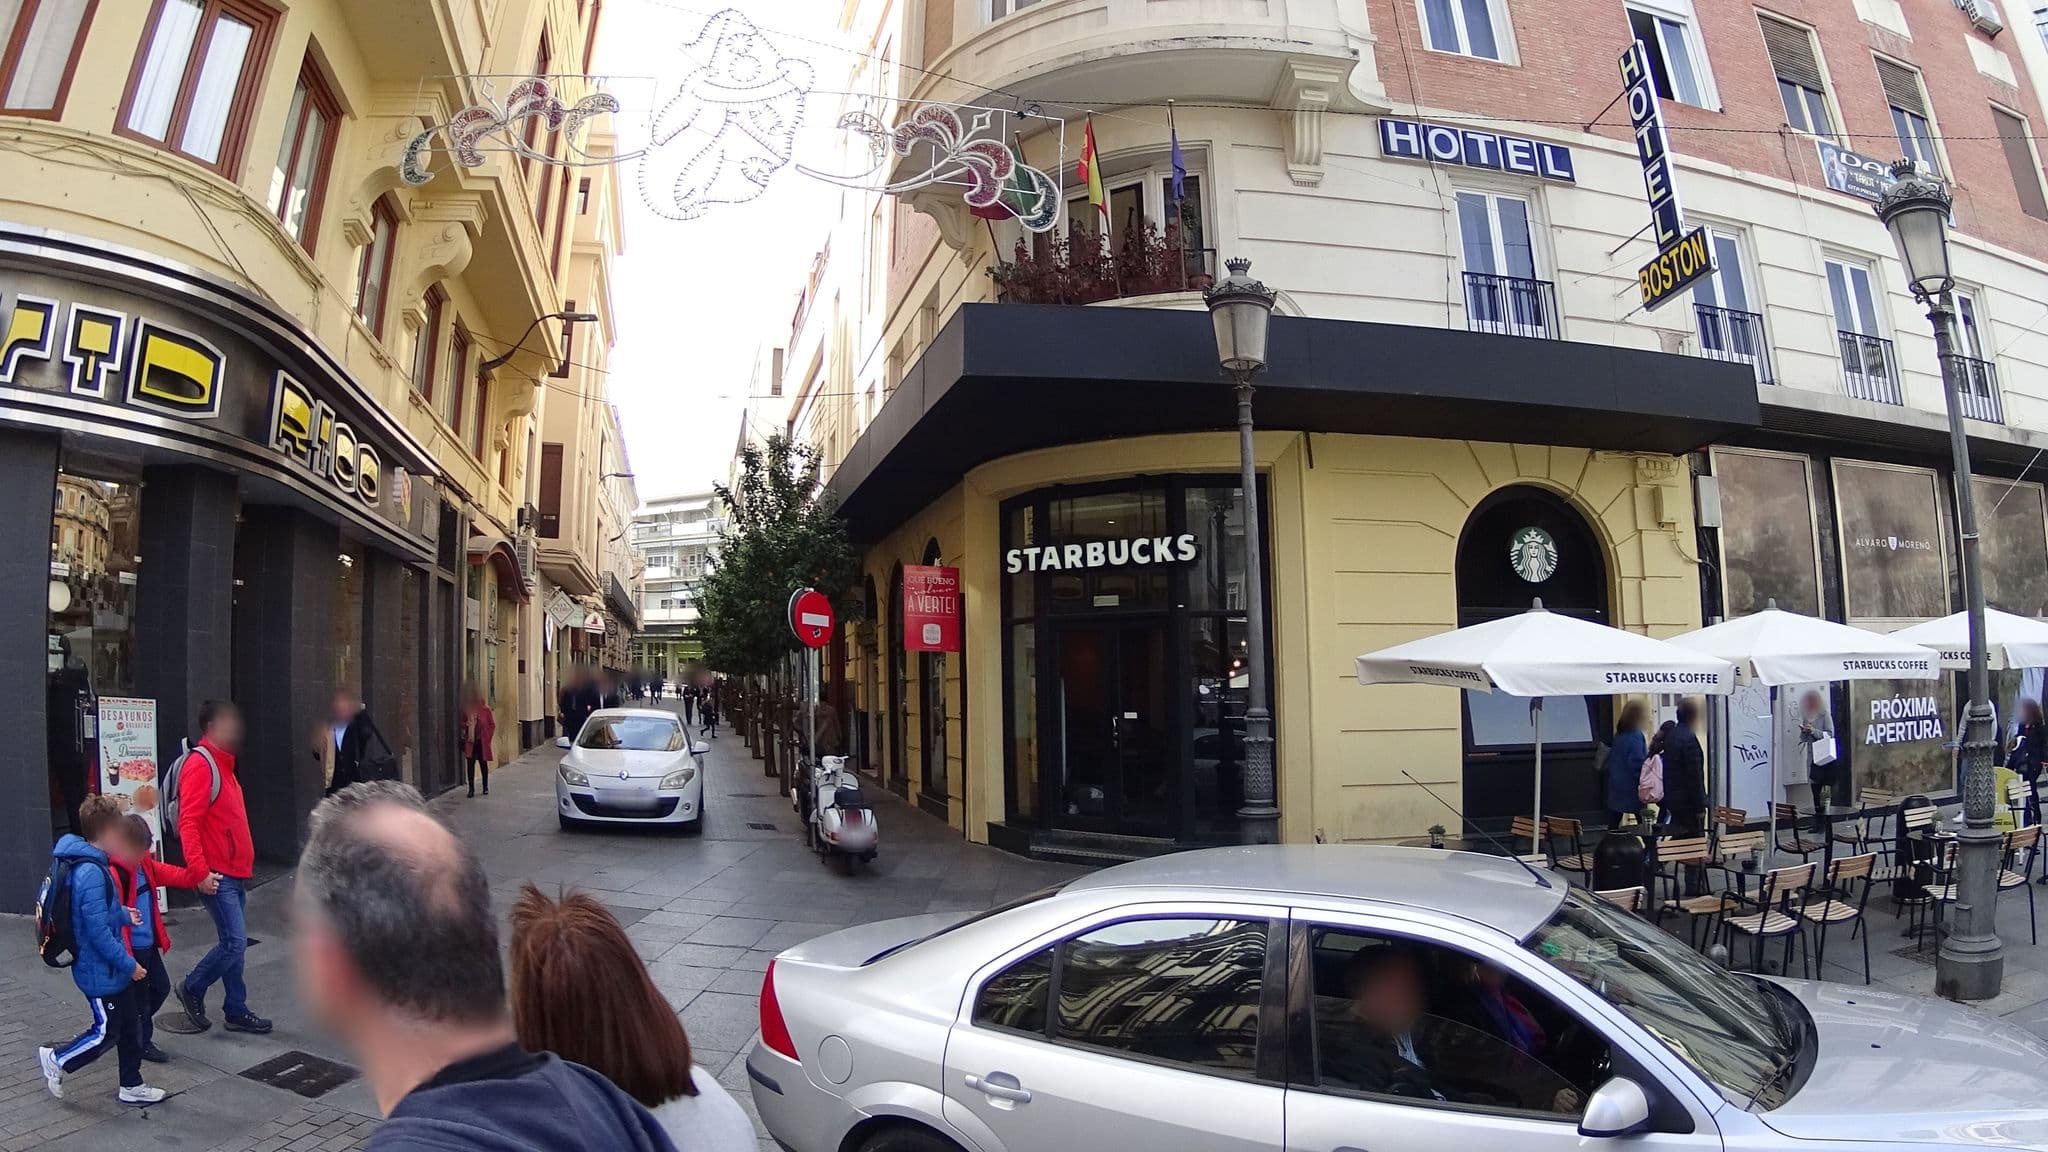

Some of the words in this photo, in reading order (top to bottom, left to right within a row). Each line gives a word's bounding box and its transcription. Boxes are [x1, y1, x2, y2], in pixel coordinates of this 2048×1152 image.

[1386, 121, 1571, 178] HOTEL
[1620, 48, 1674, 246] HOTEL
[1639, 232, 1707, 304] BOSTON
[269, 369, 381, 508] RICO
[1006, 534, 1197, 574] STARBUCKS
[1855, 538, 1887, 548] ALVARO
[1898, 540, 1931, 550] MORENO
[927, 576, 955, 585] BUENO
[908, 595, 915, 613] A
[918, 595, 956, 614] VERTE!
[1605, 672, 1677, 683] STARBUCKS
[1679, 672, 1718, 684] COFFEE
[1843, 660, 1896, 671] STARBUCKS
[1897, 660, 1928, 671] COFFEE
[101, 710, 152, 721] DESAYUNOS
[1870, 693, 1937, 720] PRÓXIMA
[1865, 718, 1943, 745] APERTURA
